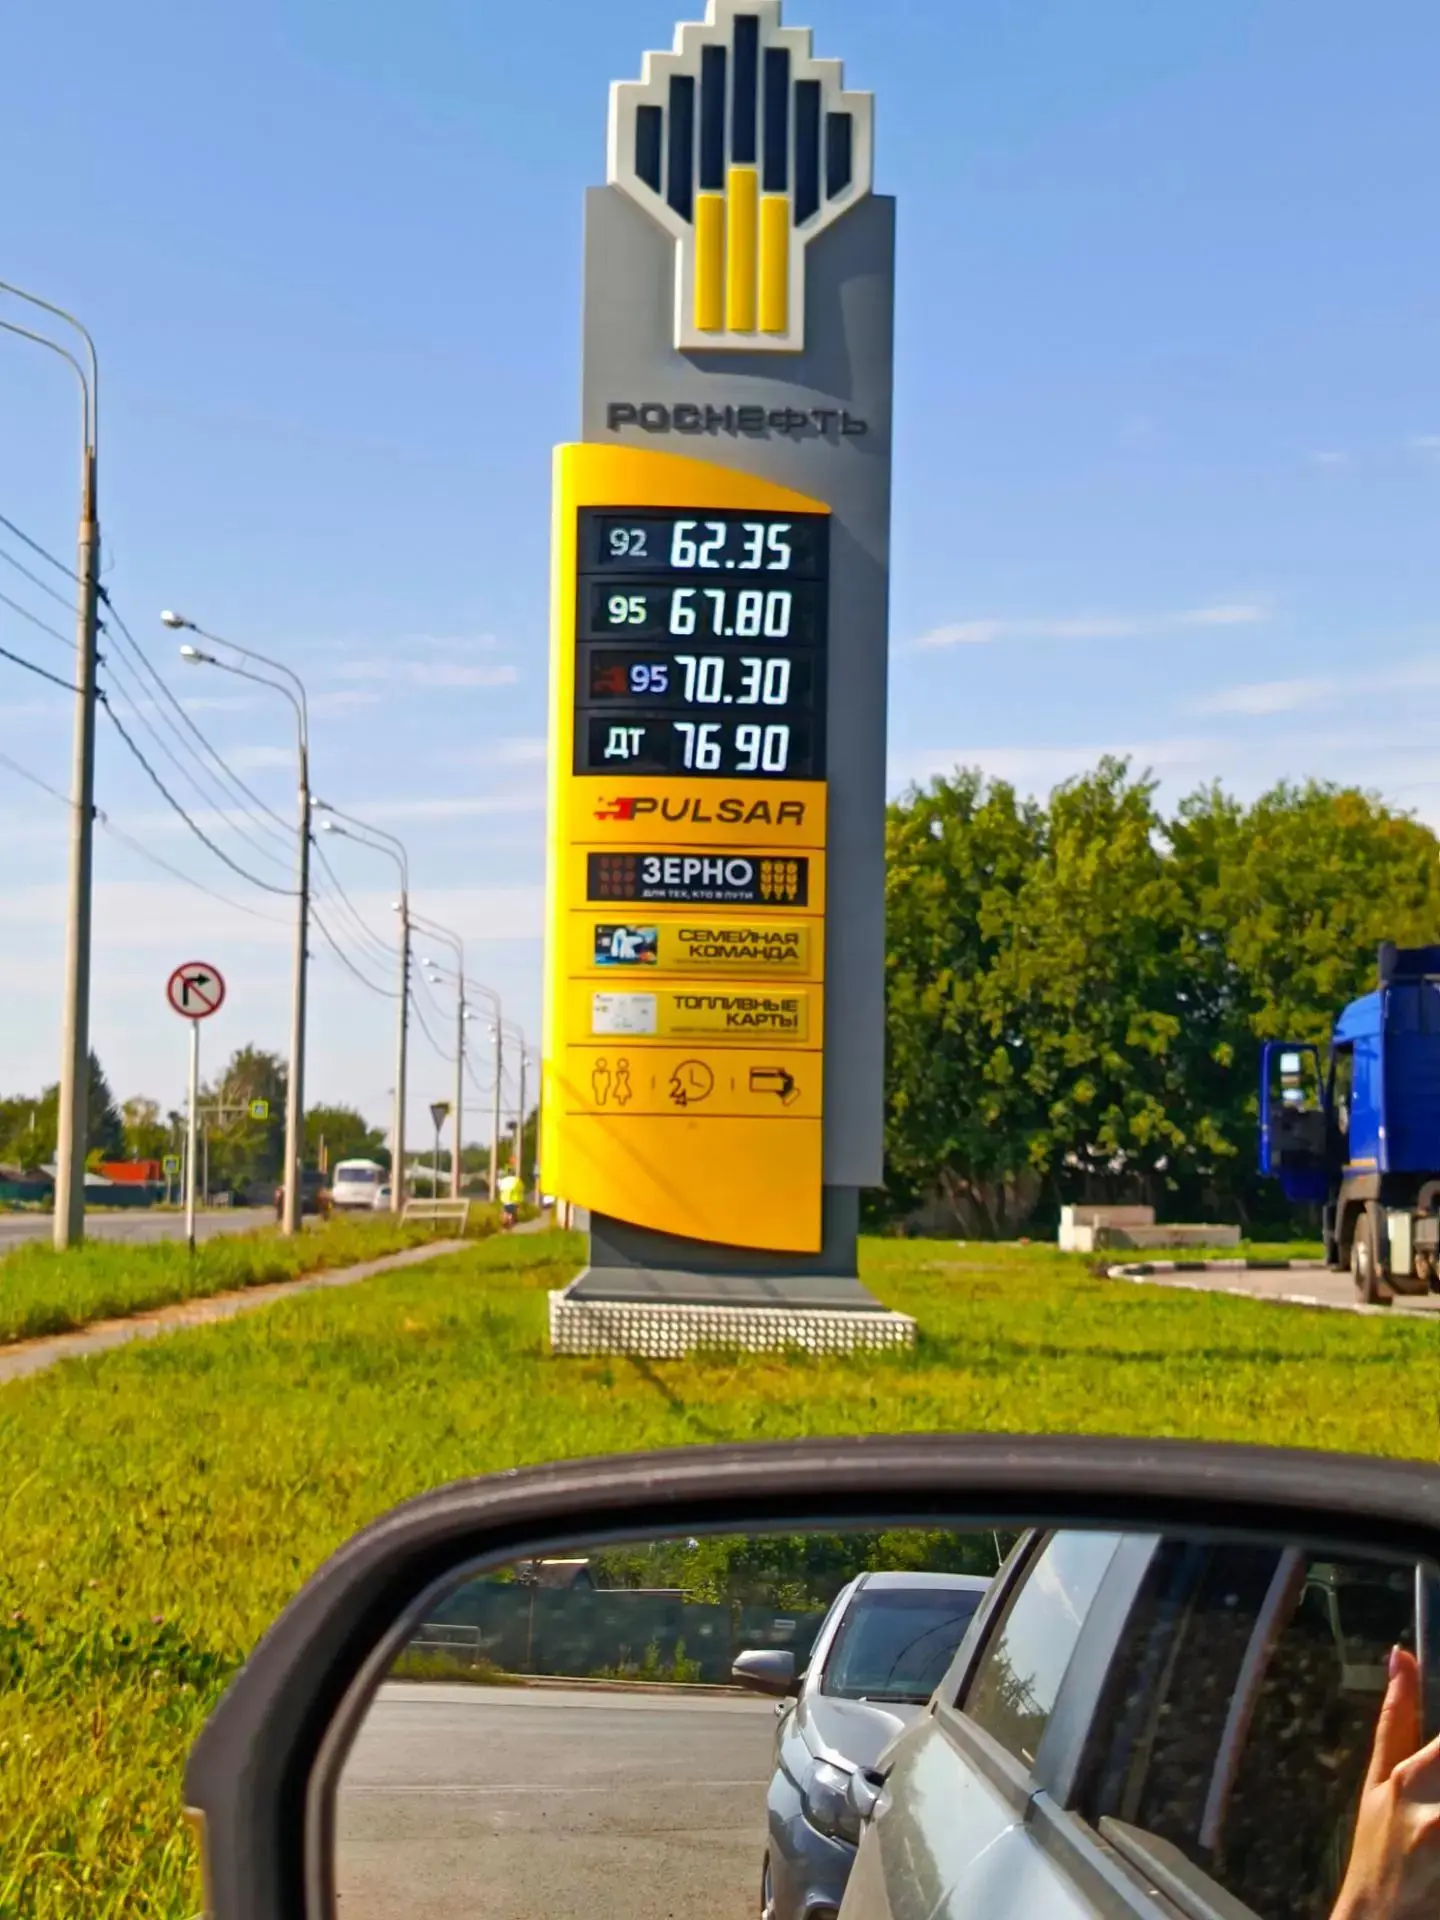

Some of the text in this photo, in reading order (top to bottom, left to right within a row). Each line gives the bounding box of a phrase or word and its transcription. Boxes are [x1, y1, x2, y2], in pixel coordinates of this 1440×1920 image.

[607, 402, 868, 437] РОСНЕФТЬ
[609, 520, 792, 570] 92 62.35
[608, 588, 792, 638] 95 67.80
[630, 655, 791, 705] 95 70.30
[603, 727, 646, 760] ДТ
[628, 797, 805, 826] PULSAR
[642, 857, 753, 886] ЗЕРНО
[678, 928, 799, 946] СЕМЕЙНАЯ
[689, 945, 799, 961] КОМАНДА
[672, 995, 799, 1013] ТОПЛИВНЫЕ
[726, 1013, 798, 1028] КАРТЫ
